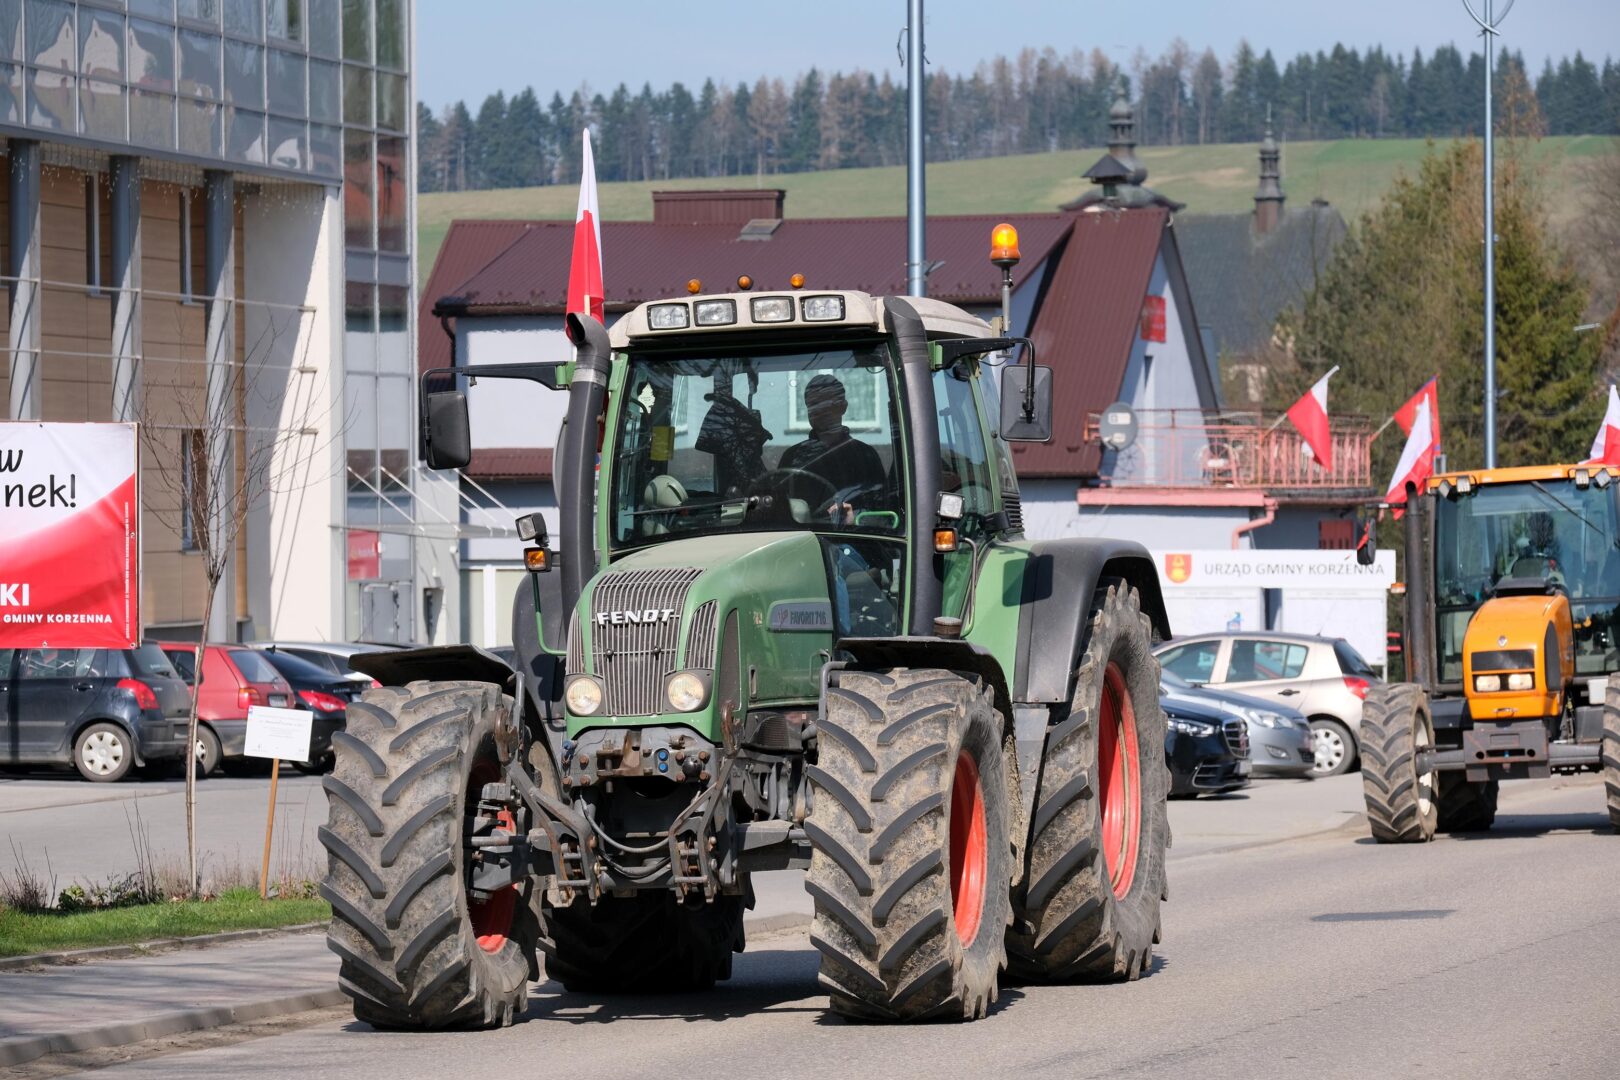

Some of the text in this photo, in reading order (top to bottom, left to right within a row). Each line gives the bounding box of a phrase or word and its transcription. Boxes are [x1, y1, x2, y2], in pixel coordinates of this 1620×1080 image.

[5, 474, 76, 508] nek!
[1204, 563, 1385, 577] URZĄD GMINY KORZENNA
[0, 583, 30, 606] KI
[3, 614, 113, 624] GMINY KORZENNA
[597, 608, 674, 625] FENDT
[790, 611, 814, 625] FAVORIT
